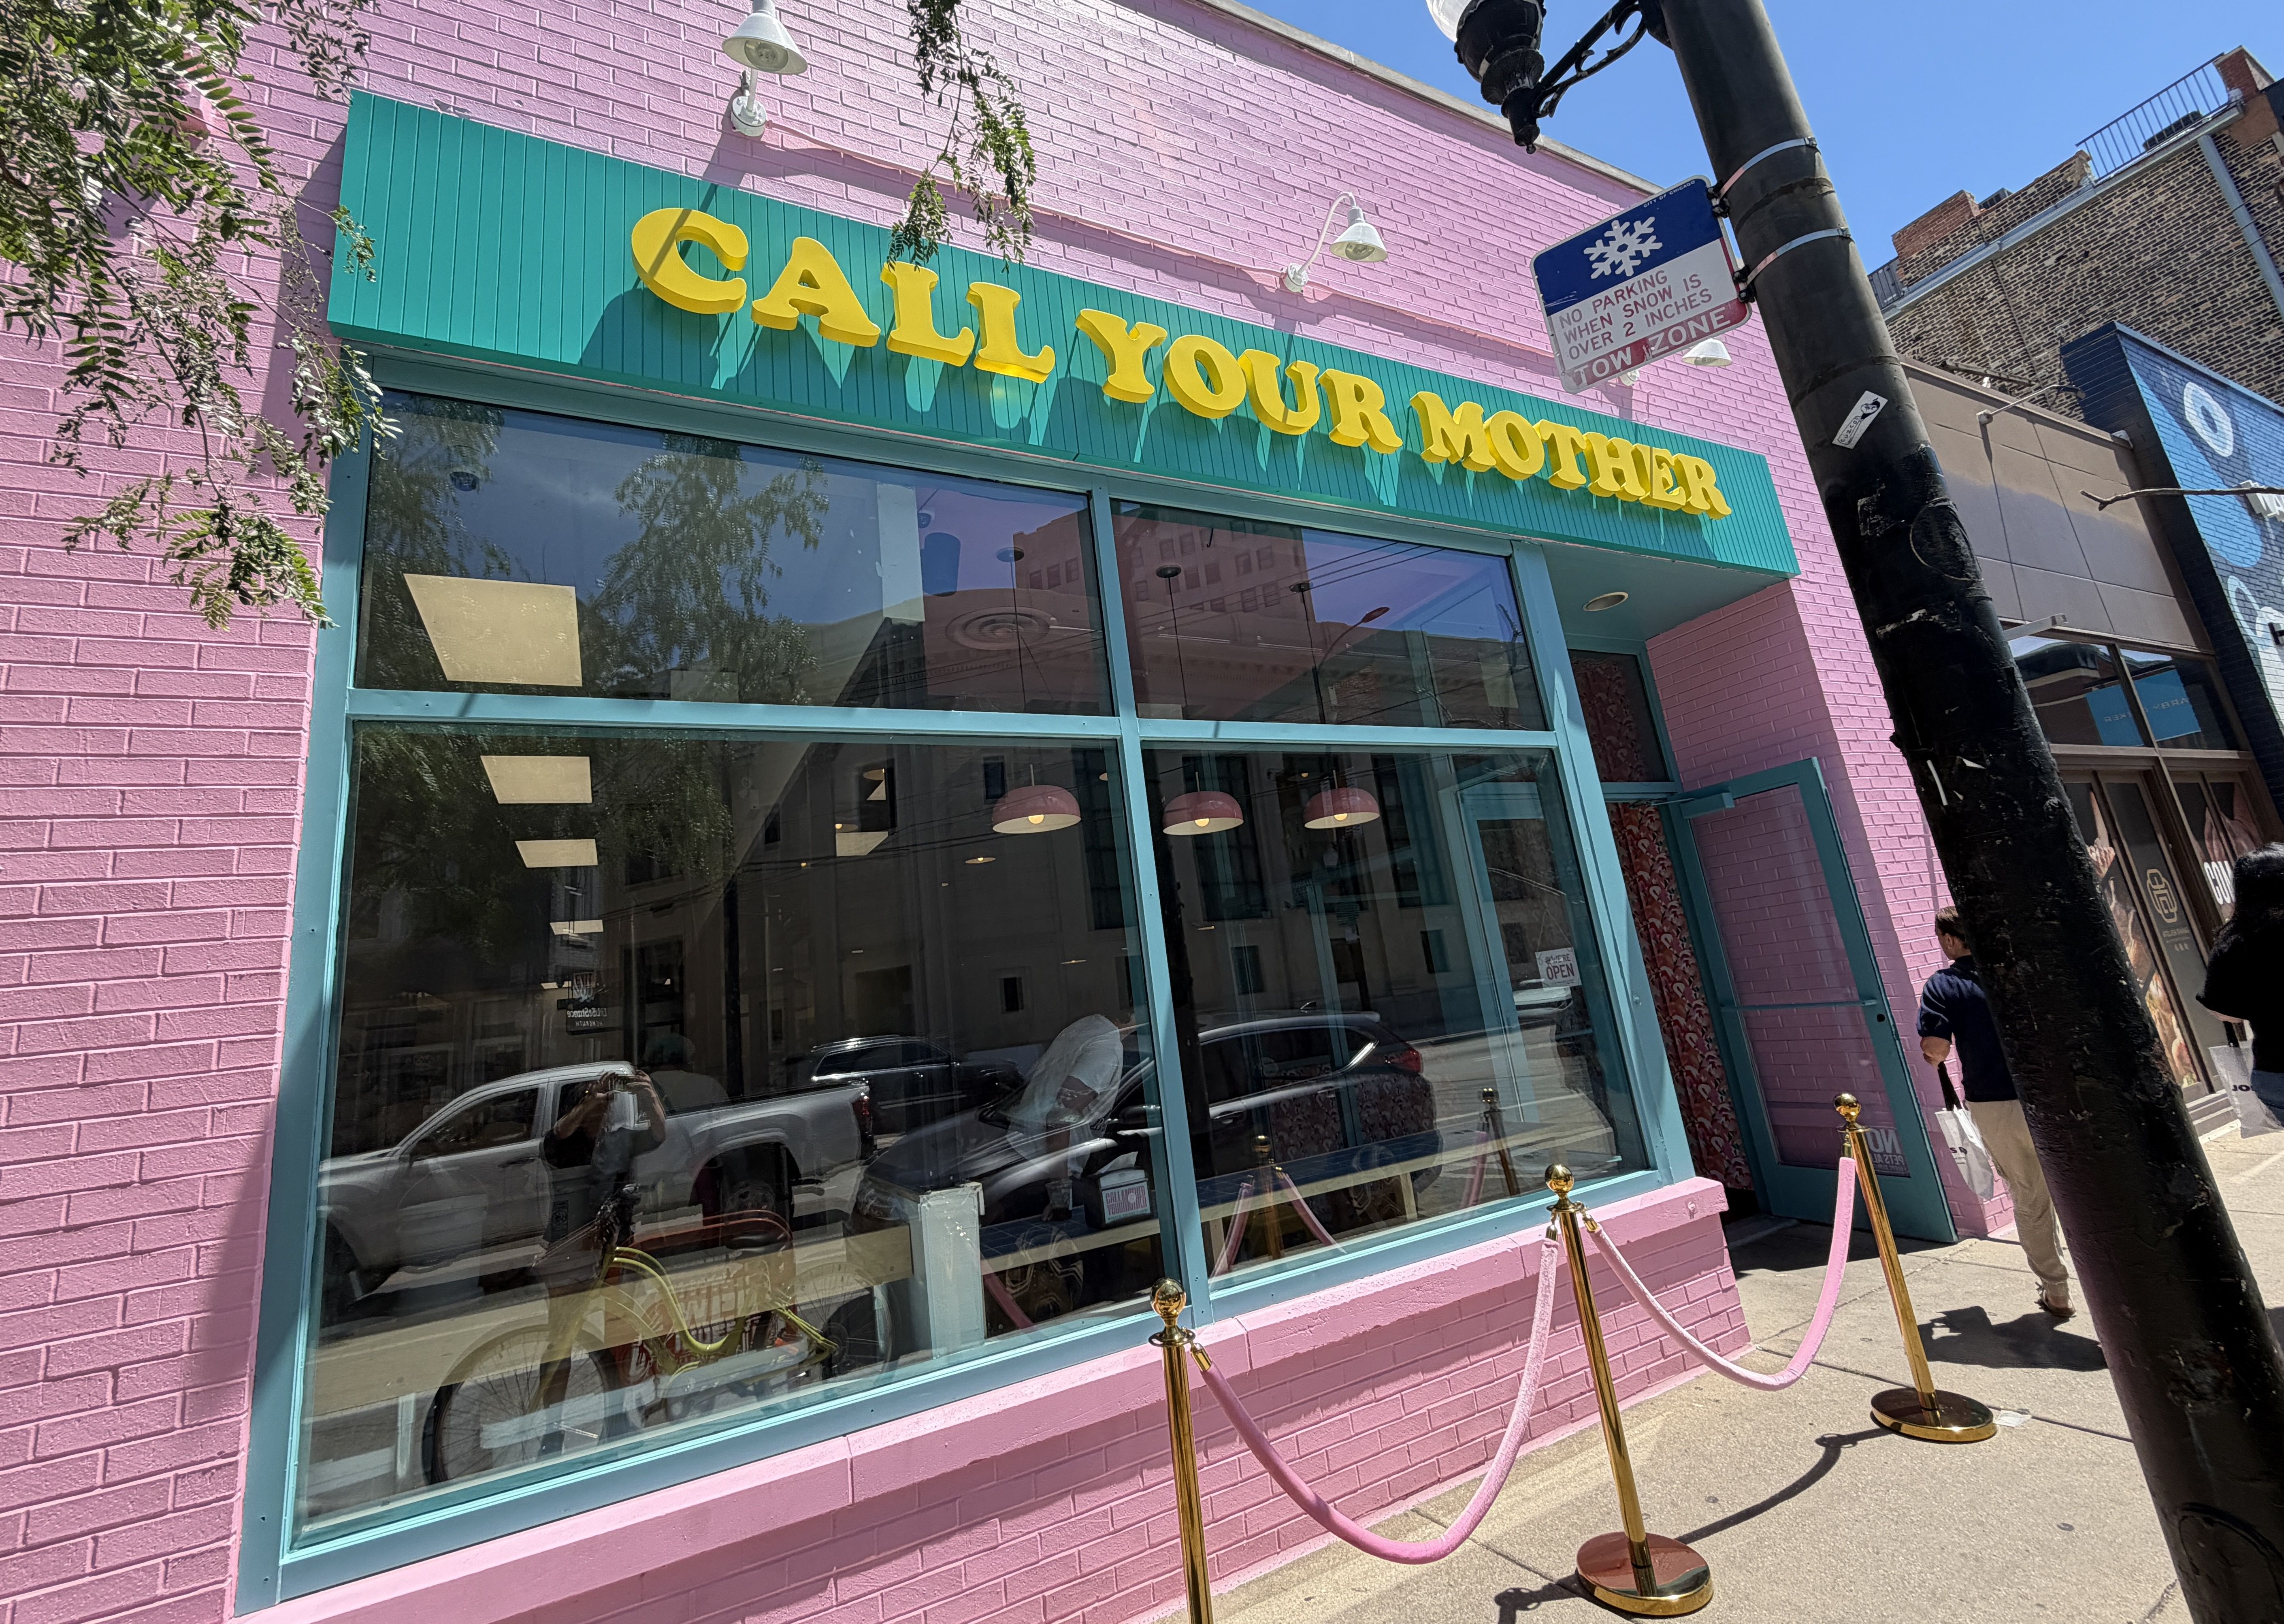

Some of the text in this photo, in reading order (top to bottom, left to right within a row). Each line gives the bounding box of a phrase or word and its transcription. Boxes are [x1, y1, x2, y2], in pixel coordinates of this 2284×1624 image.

[1643, 199, 1657, 208] CITY
[1669, 180, 1696, 195] CHICAGO
[1559, 270, 1668, 329] NO PARKING
[1564, 274, 1701, 344] WHEN SNOW IS
[1569, 288, 1712, 360] OVER 2 INCHES
[1574, 307, 1730, 386] TOW ZONE
[631, 207, 1732, 520] CALL YOUR MOTHER
[1841, 420, 1857, 442] CUZCO
[2203, 860, 2236, 905] COM
[1546, 963, 1575, 980] OPEN
[1106, 1191, 1121, 1204] CALL
[1108, 1201, 1124, 1215] YOUR
